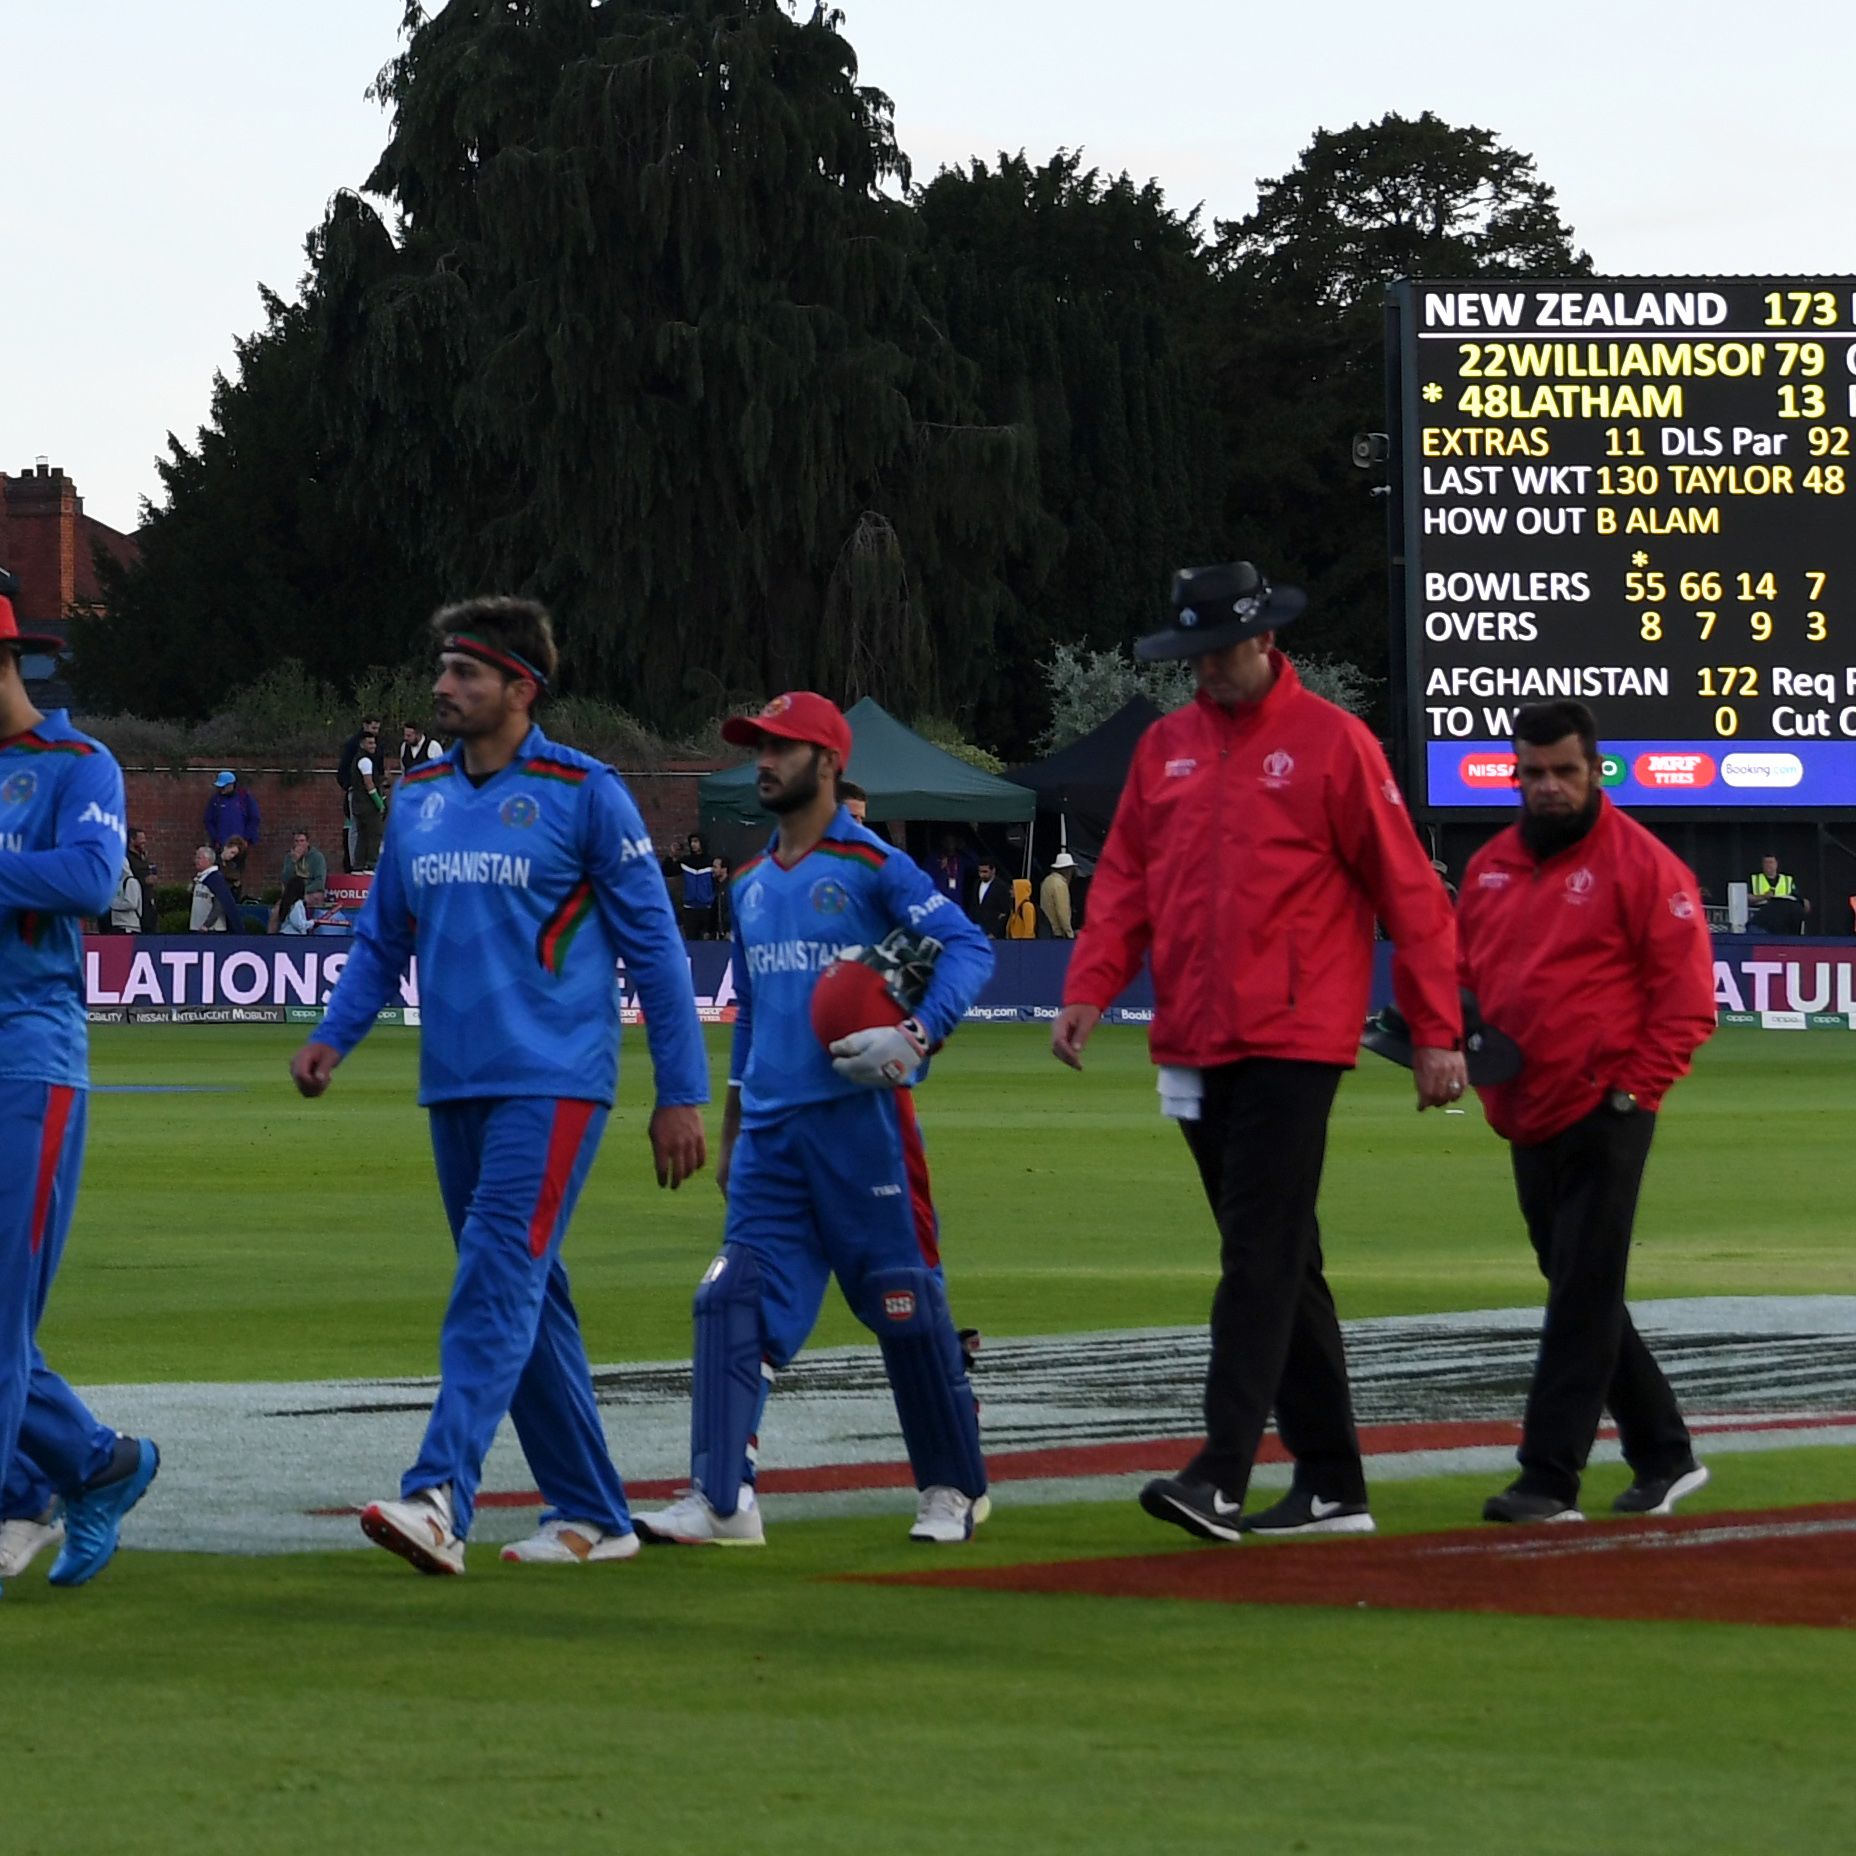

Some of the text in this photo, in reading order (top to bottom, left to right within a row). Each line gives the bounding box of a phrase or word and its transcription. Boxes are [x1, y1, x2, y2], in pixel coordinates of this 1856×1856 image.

[1425, 293, 1525, 326] NEW
[1536, 293, 1727, 326] ZEALAND
[1763, 292, 1838, 326] 173
[1774, 343, 1825, 376] 79
[1777, 384, 1826, 418] 13
[1422, 426, 1850, 457] EXTRAS 11 DLS Par 92
[1423, 465, 1846, 495] LAST WKT 130 TAYLOR 48
[1424, 507, 1720, 535] HOW OUT B ALAM
[1425, 572, 1827, 602] BOWLERS 55 66 14 7
[1425, 611, 1828, 641] OVERS 8 7 9 3
[1426, 667, 1669, 697] AFGHANISTAN
[1697, 667, 1759, 697] 172
[1772, 667, 1835, 703] Req
[1426, 707, 1473, 737] TO
[1715, 707, 1738, 736] 0
[1771, 707, 1829, 737] Cut
[1648, 756, 1701, 771] MRF
[1654, 772, 1695, 785] TYRES
[1726, 764, 1798, 778] Booking.com
[86, 1012, 123, 1022] OBILITY
[136, 1013, 169, 1023] NISSAN
